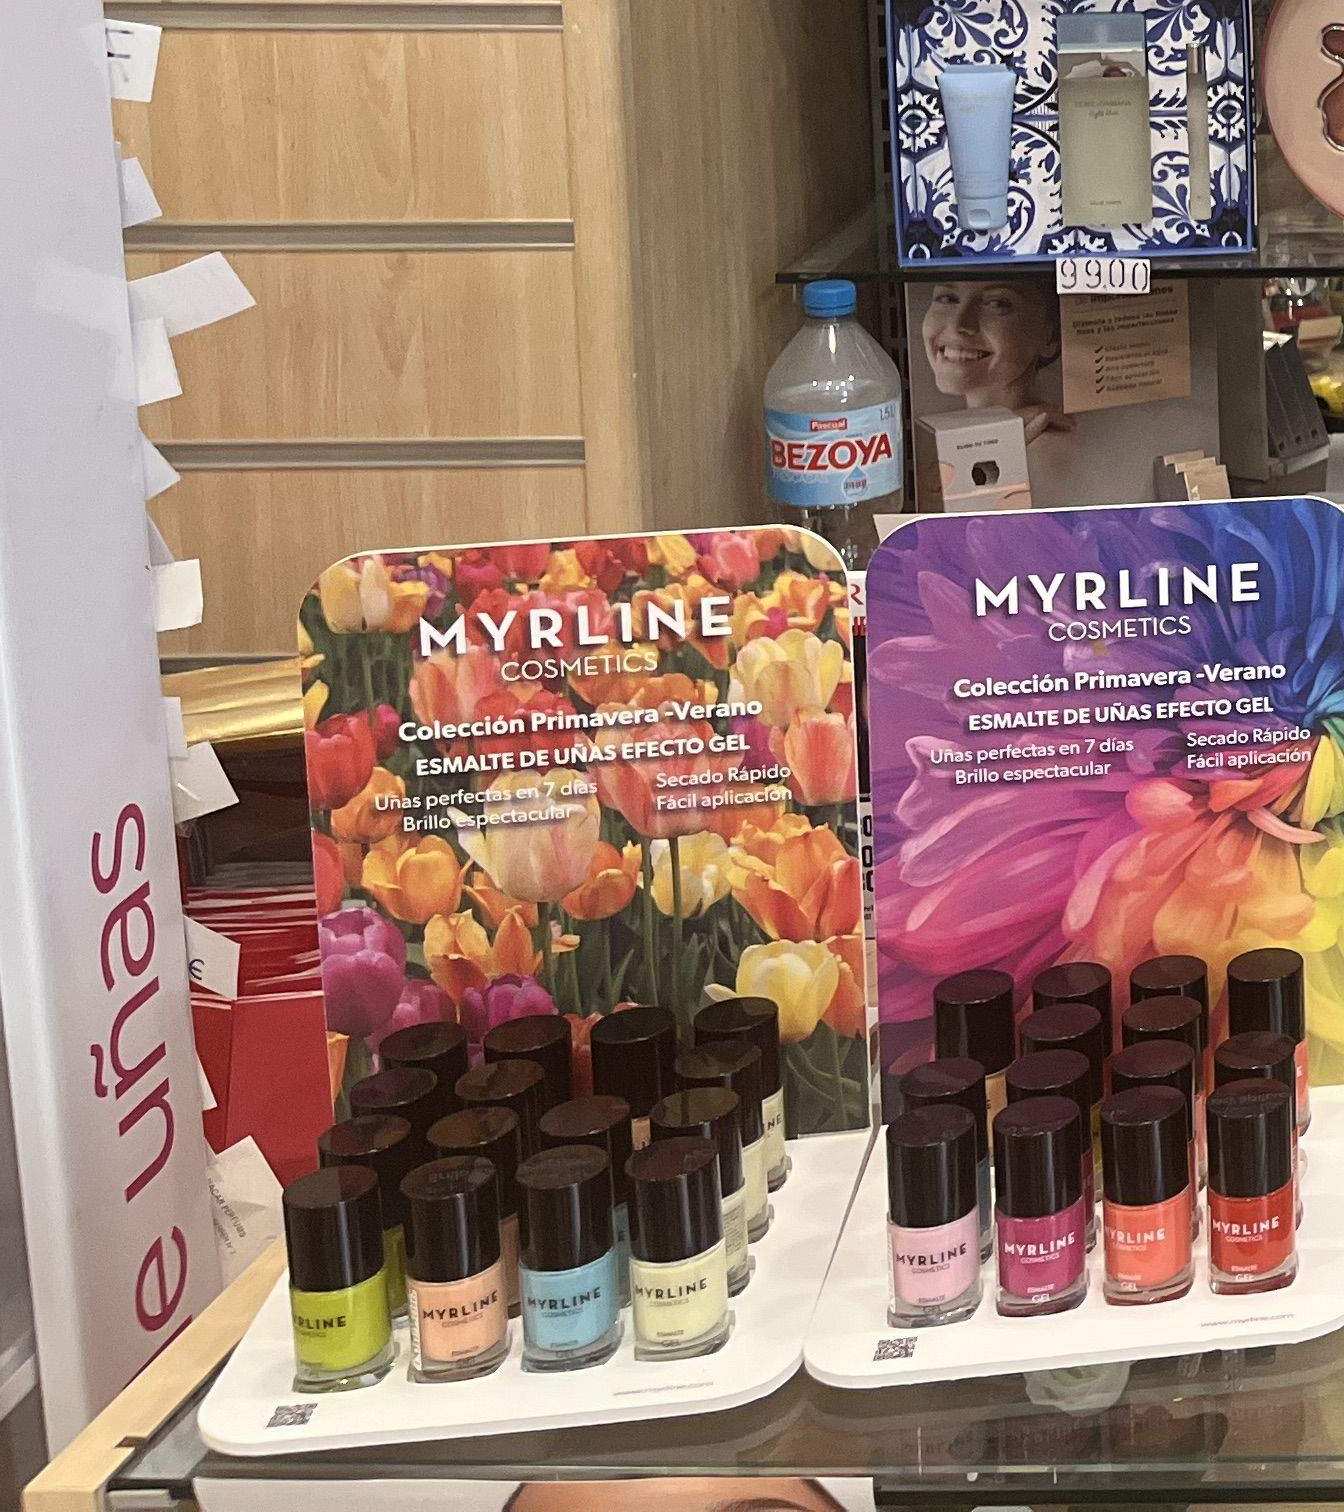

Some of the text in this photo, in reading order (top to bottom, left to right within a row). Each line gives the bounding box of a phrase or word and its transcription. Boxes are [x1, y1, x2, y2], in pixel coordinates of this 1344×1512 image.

[772, 433, 892, 471] BEZOYA
[974, 562, 1260, 617] MYRLINE
[419, 594, 733, 657] MYRLINE
[1048, 615, 1192, 643] COSMETICS
[500, 651, 658, 682] COSMETICS
[953, 672, 1071, 699] Colección
[1075, 666, 1192, 693] Primavera
[398, 714, 525, 744] Colección
[531, 704, 660, 732] Primavera
[968, 696, 1274, 733] ESMALTE DE UÑAS EFECTO GEL
[930, 736, 1135, 765] Uñas perfectas en 7 días
[1187, 724, 1311, 749] Secado Rápido
[415, 734, 751, 777] ESMALTE DE UÑAS EFECTO GEL
[1187, 746, 1312, 770] Fácil aplicación
[656, 763, 791, 790] Secado Rápido
[955, 760, 1112, 786] Brillo espectacular
[656, 784, 793, 812] Fácil aplicación
[402, 803, 574, 833] Brillo espectacular
[91, 803, 175, 1203] uñas
[1212, 1217, 1280, 1235] MYRLINE
[896, 1243, 968, 1267] MYRLINE
[1004, 1232, 1076, 1257] MYRLINE
[527, 1287, 601, 1310] MYRLINE
[635, 1278, 708, 1300] MYRLINE
[422, 1291, 499, 1322] MYRLINE
